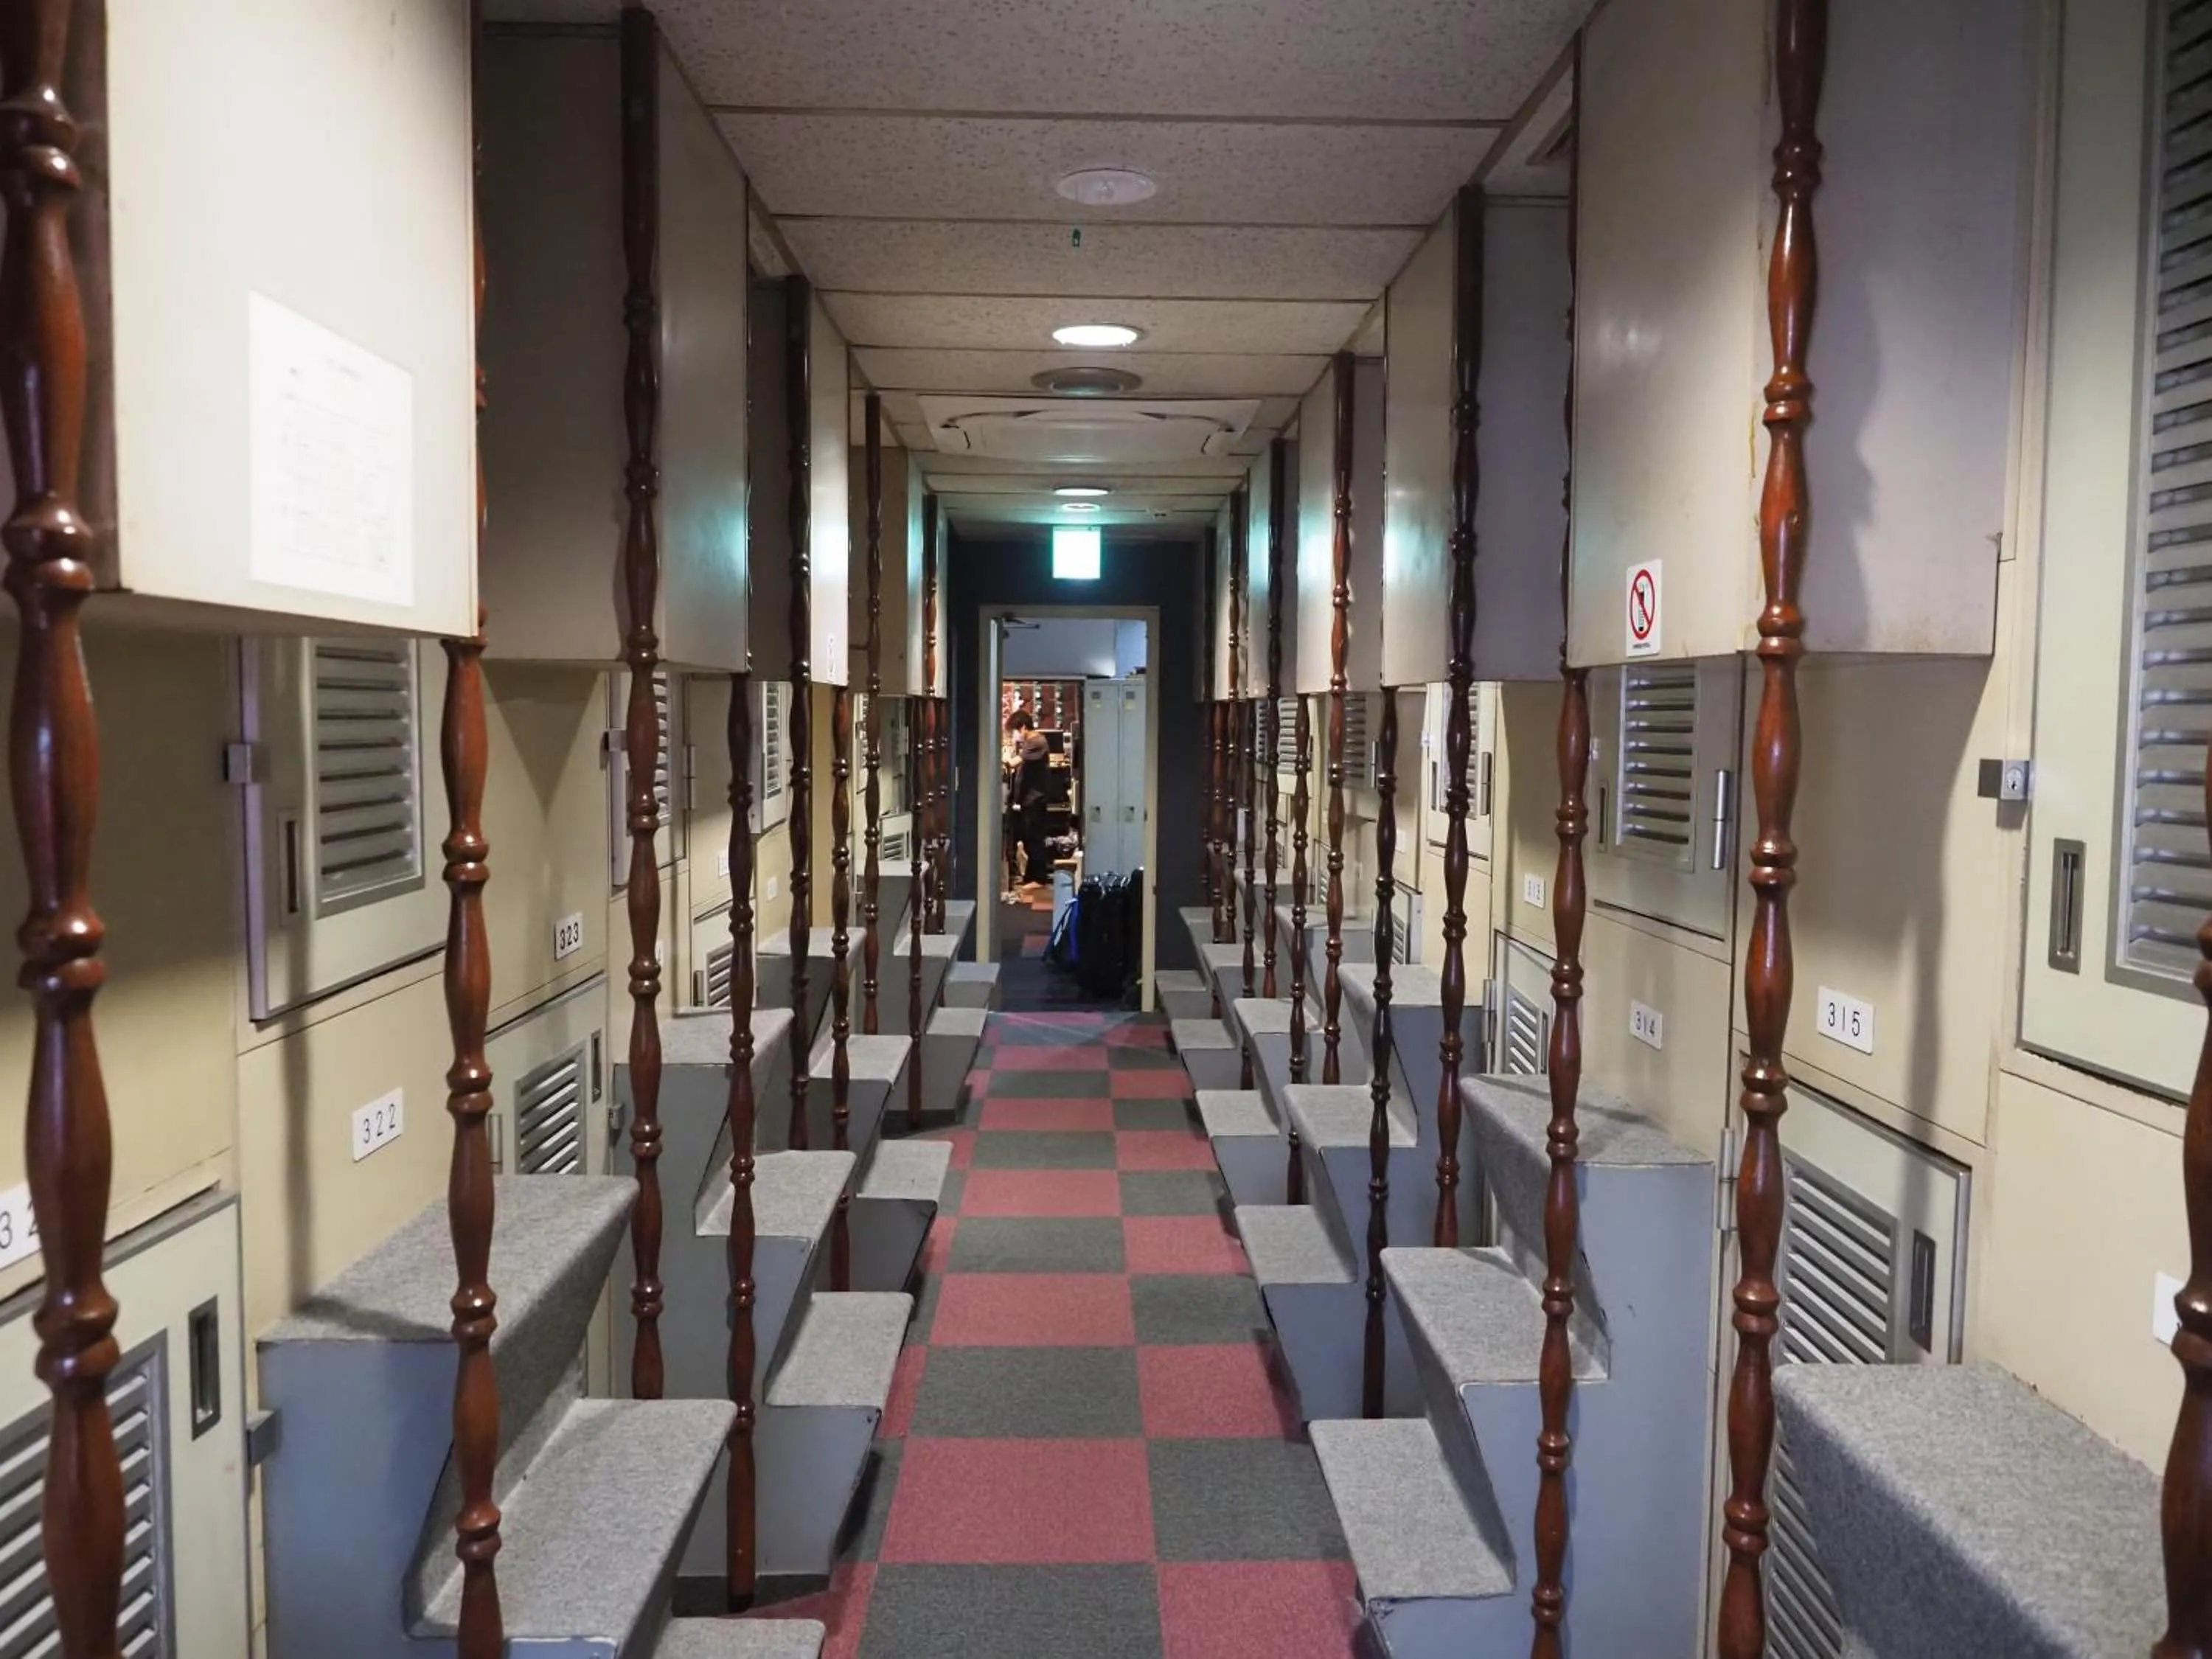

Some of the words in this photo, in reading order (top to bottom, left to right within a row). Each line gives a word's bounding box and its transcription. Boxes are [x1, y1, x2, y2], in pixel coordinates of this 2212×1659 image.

[560, 922, 578, 950] 323
[1636, 1011, 1655, 1037] 314
[1829, 1002, 1860, 1037] 315
[364, 1103, 395, 1144] 322
